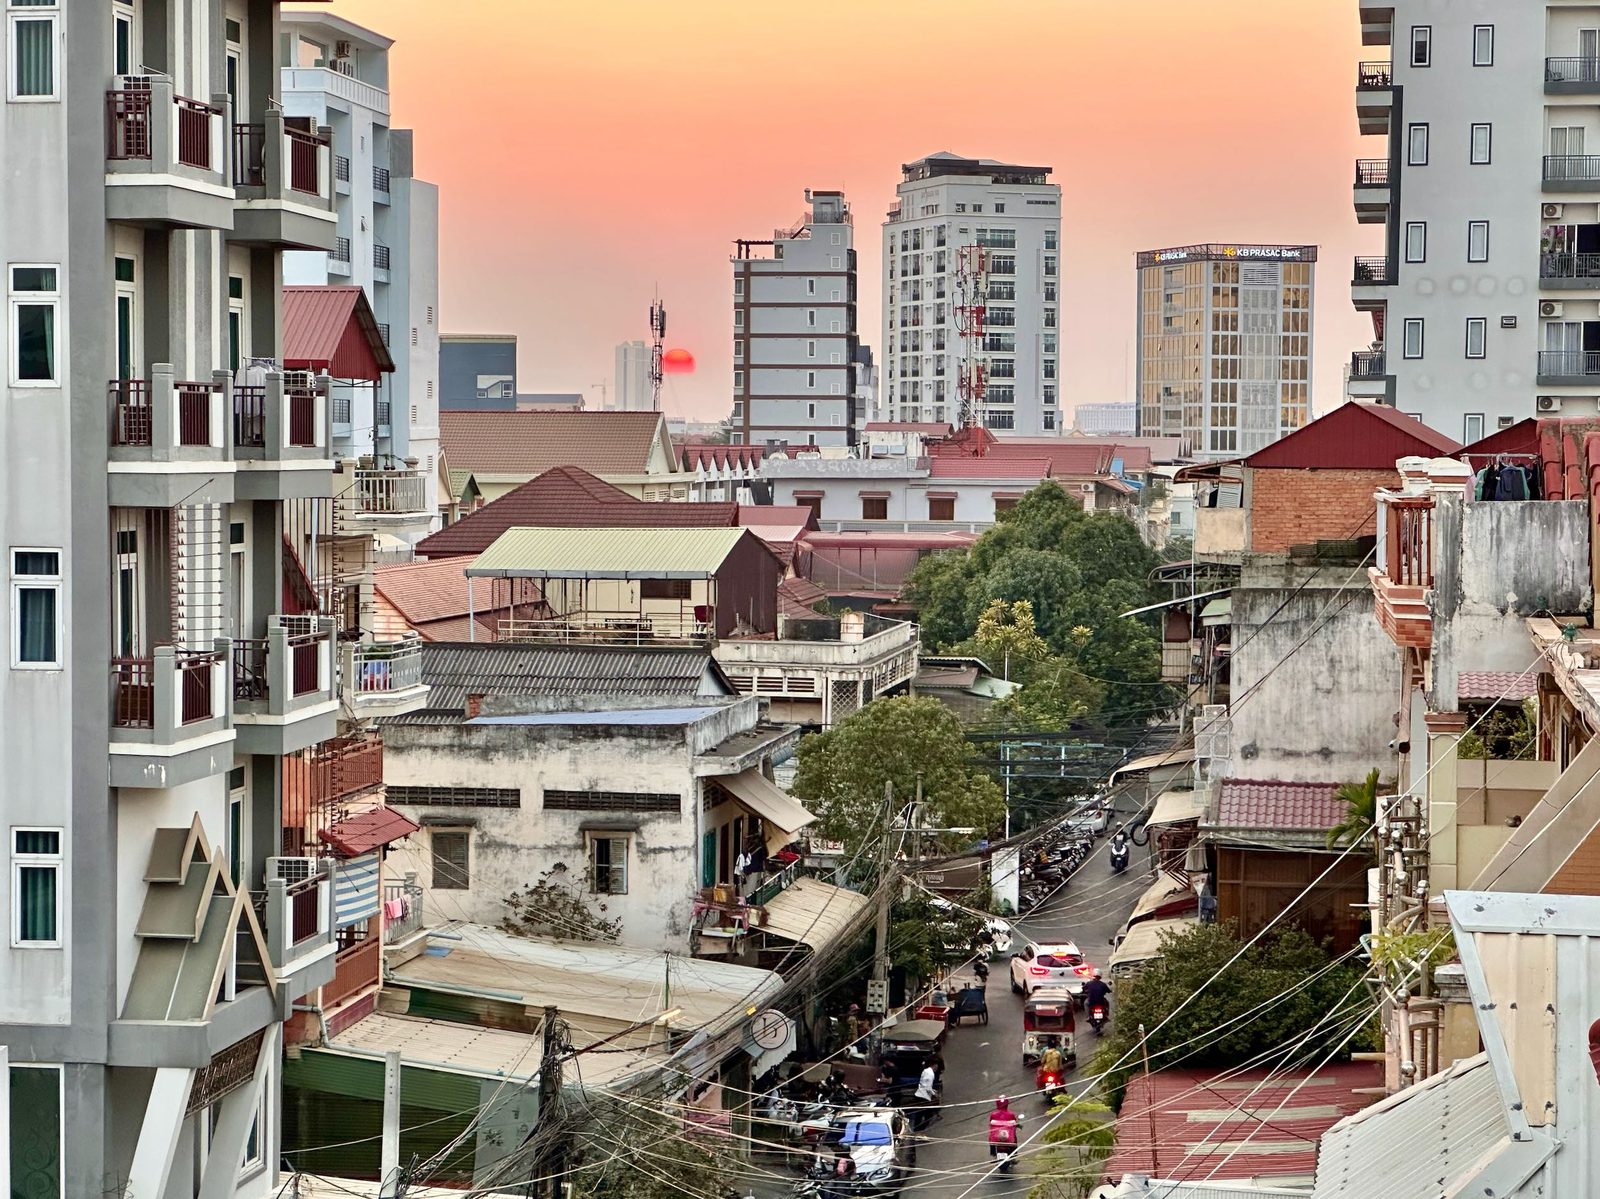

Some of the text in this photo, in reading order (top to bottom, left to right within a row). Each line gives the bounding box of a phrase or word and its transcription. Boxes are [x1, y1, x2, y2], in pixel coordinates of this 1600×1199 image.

[1237, 249, 1300, 257] KB PRASAC Bank
